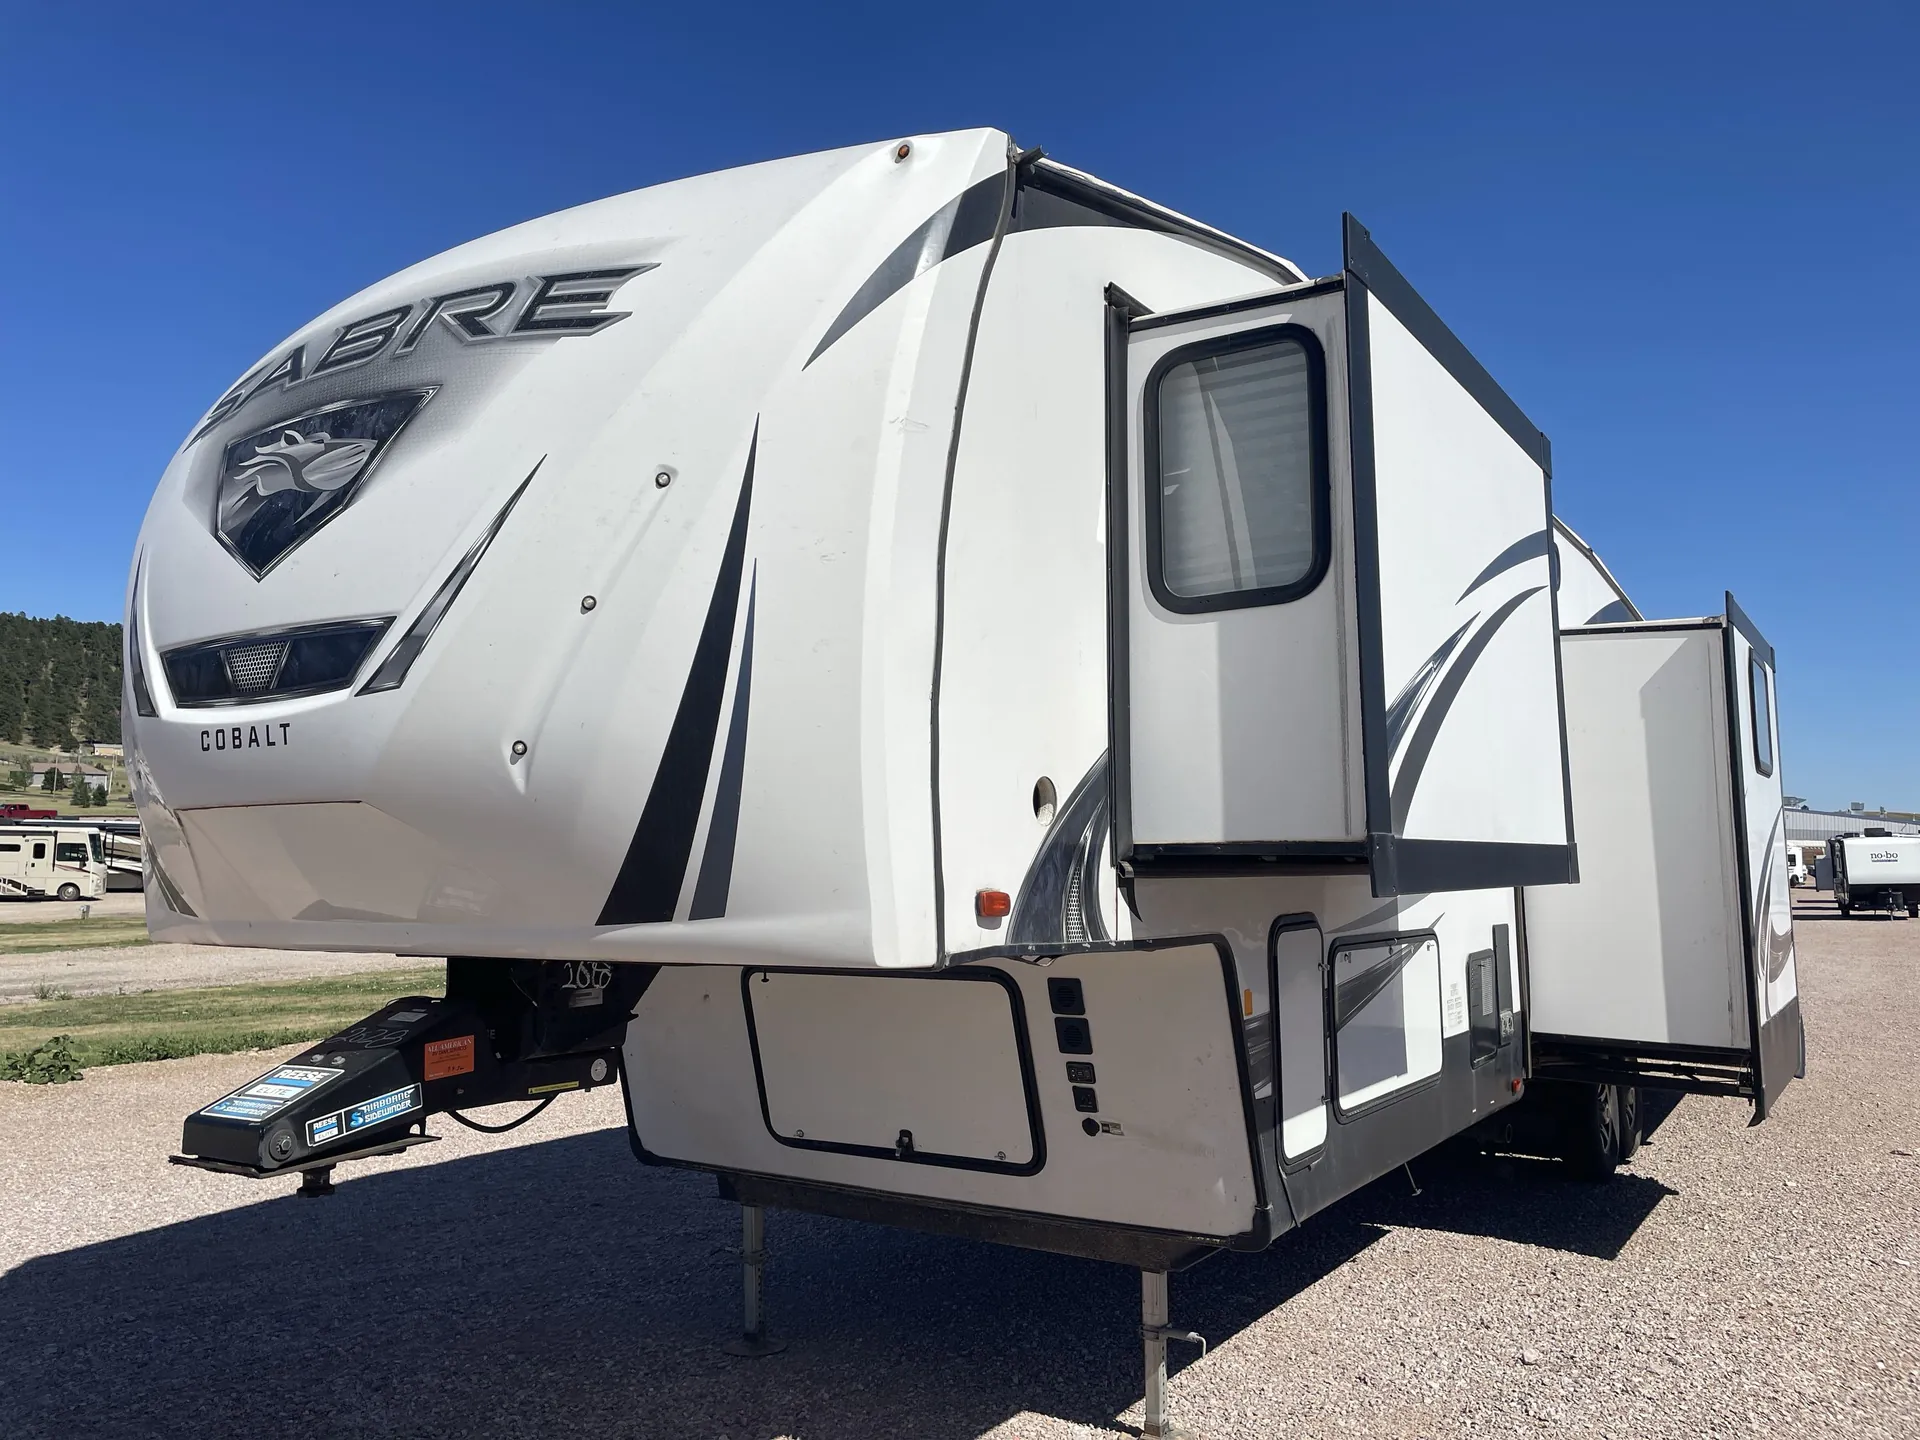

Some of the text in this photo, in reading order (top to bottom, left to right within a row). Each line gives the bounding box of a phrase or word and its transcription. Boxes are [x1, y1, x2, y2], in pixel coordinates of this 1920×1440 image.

[182, 262, 661, 454] SABRE
[201, 722, 290, 752] COBALT
[439, 1038, 472, 1050] AMERICAN
[273, 1069, 330, 1081] REESE
[256, 1086, 293, 1096] ELITE
[358, 1088, 416, 1113] AIRBORNE
[364, 1099, 413, 1123] SIDEWINDER
[313, 1115, 338, 1130] REESE
